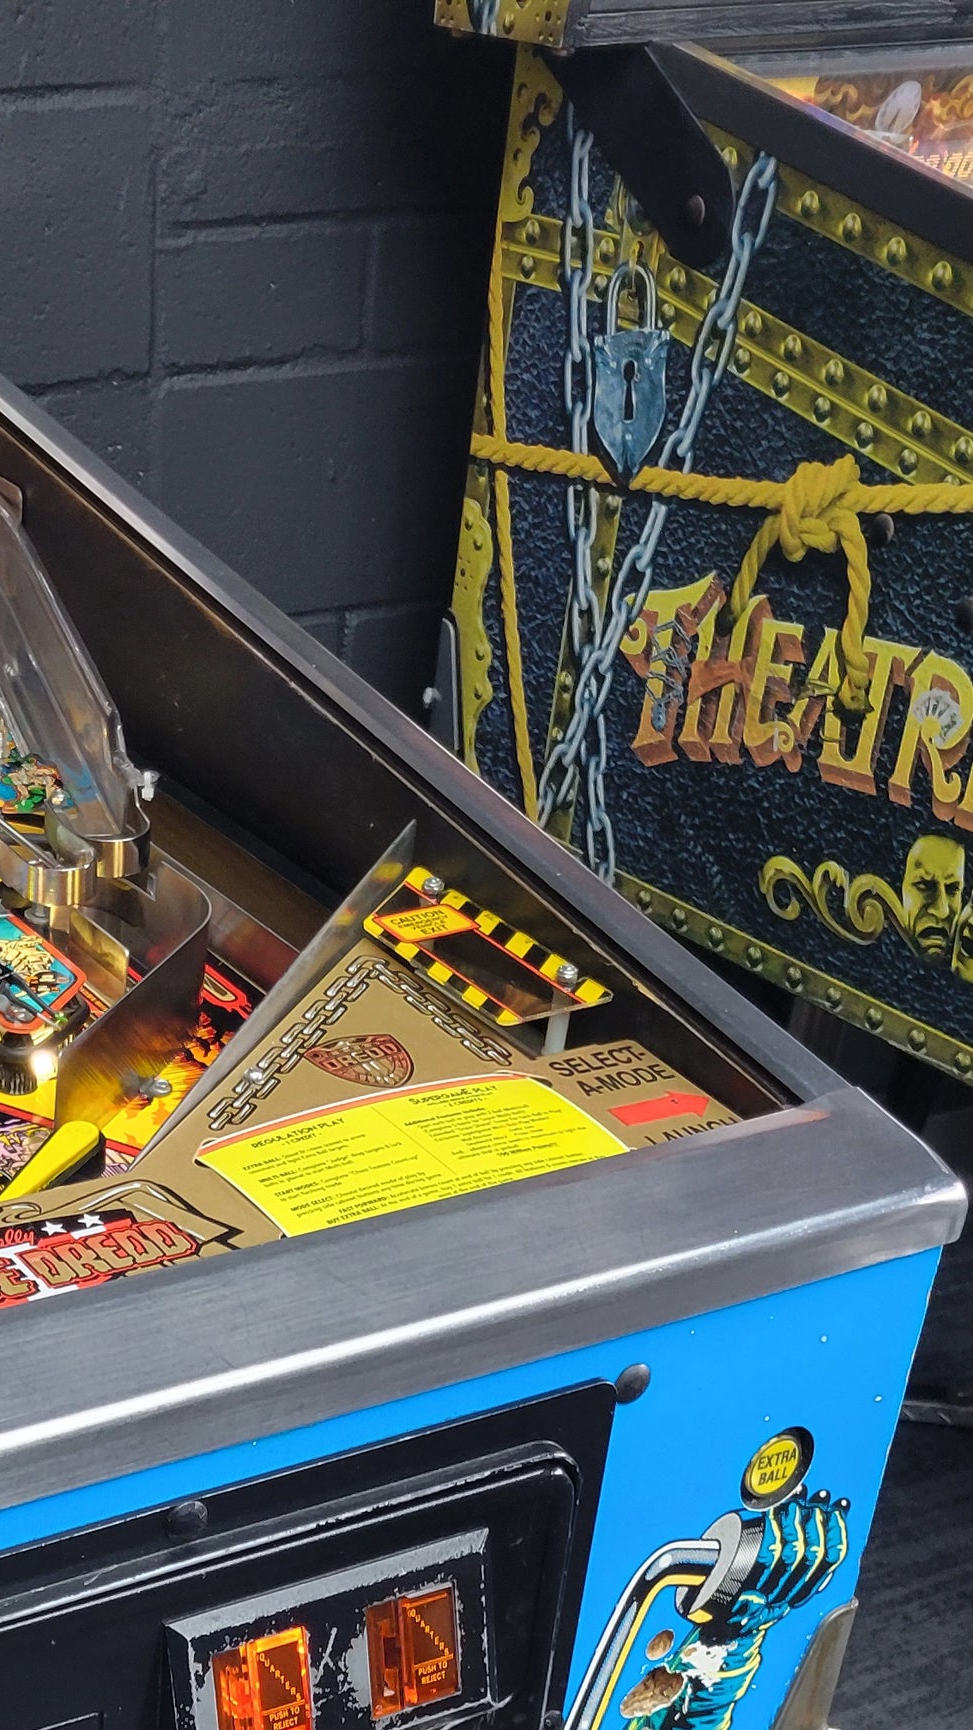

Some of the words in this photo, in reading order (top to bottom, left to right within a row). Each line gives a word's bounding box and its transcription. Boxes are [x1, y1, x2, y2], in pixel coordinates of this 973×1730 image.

[619, 570, 973, 832] THEATR
[390, 909, 445, 926] CAUTION
[420, 924, 449, 935] EXIT
[547, 1044, 647, 1080] SELECT-
[577, 1062, 677, 1098] A-MODE
[251, 1126, 316, 1149] REGULATION
[317, 1117, 345, 1130] PLAY
[16, 1220, 202, 1290] DREDD
[757, 1447, 797, 1471] EXTRA
[757, 1466, 788, 1487] BALL
[407, 1607, 451, 1656] QUARTERS
[258, 1652, 302, 1702] QUARTERS
[418, 1663, 436, 1677] PUSH
[436, 1660, 448, 1671] TO
[421, 1671, 447, 1685] REJECT
[268, 1707, 290, 1723] PUSH
[291, 1705, 301, 1718] TO
[273, 1717, 299, 1730] REJECT
